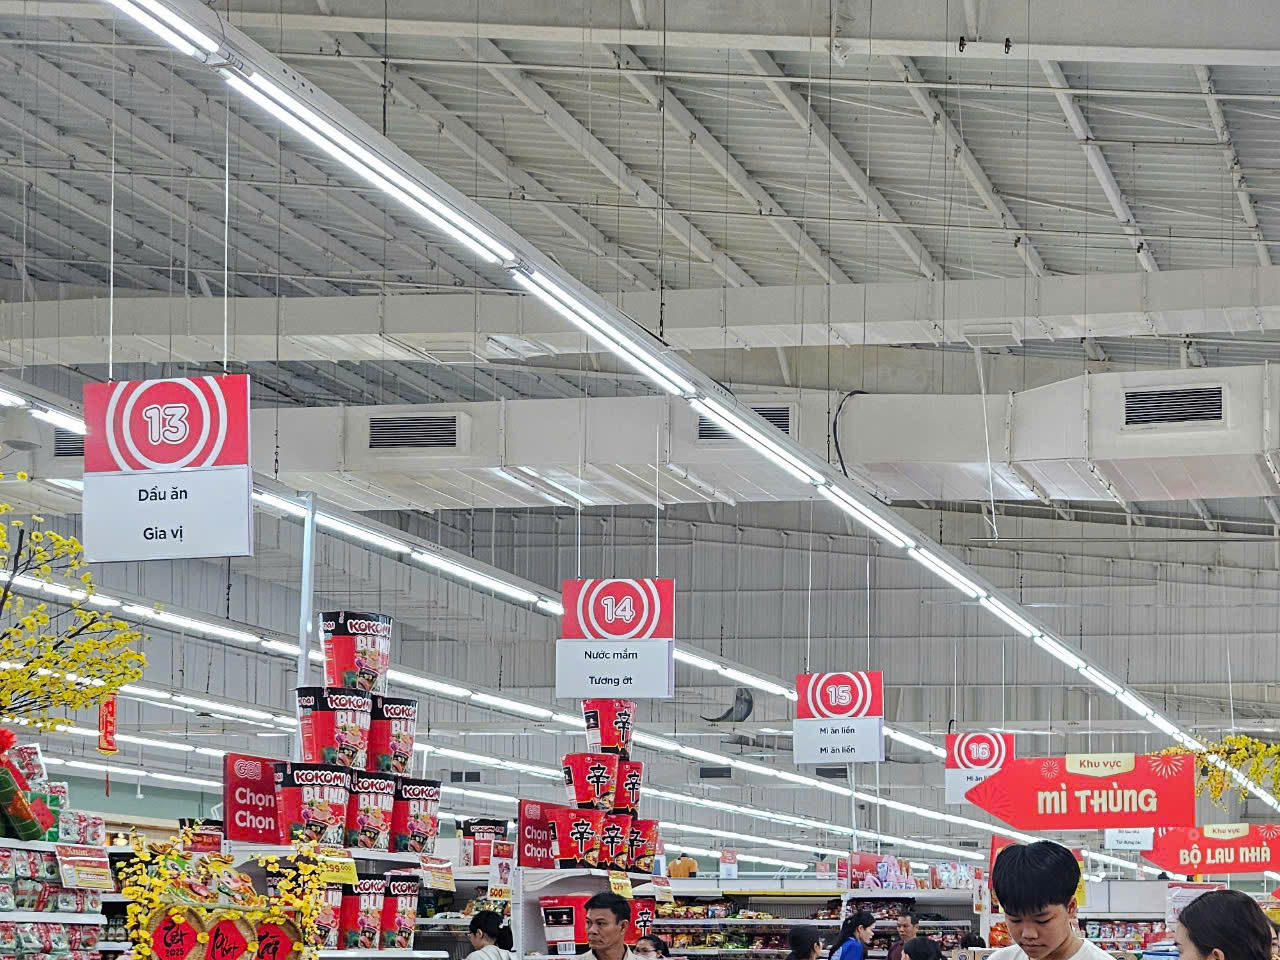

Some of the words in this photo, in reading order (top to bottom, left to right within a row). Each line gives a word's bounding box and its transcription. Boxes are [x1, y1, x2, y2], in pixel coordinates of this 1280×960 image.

[142, 404, 190, 447] 13
[138, 485, 167, 502] Dầu
[170, 486, 188, 501] ăn
[142, 526, 167, 541] Gia
[170, 525, 184, 543] vị
[600, 595, 636, 624] 14
[584, 648, 611, 660] Nước
[612, 647, 638, 660] mắm
[588, 675, 620, 687] Tương
[622, 674, 633, 686] ớt
[825, 683, 853, 707] 15
[614, 710, 633, 742] 辛
[969, 742, 991, 759] 16
[1079, 759, 1100, 769] Khu
[1102, 760, 1122, 771] vực
[586, 763, 611, 797] 辛
[624, 771, 641, 803] 辛
[234, 787, 276, 812] Chọn
[1074, 781, 1158, 814] THÙNG
[234, 810, 276, 834] Chọn
[524, 826, 547, 843] Chọn
[570, 819, 594, 853] 辛
[601, 824, 624, 858] 辛
[524, 843, 547, 861] Chọn
[1179, 843, 1202, 869] BỘ
[1206, 847, 1235, 865] LAU
[1239, 841, 1271, 864] NHÀ
[635, 908, 653, 937] 辛
